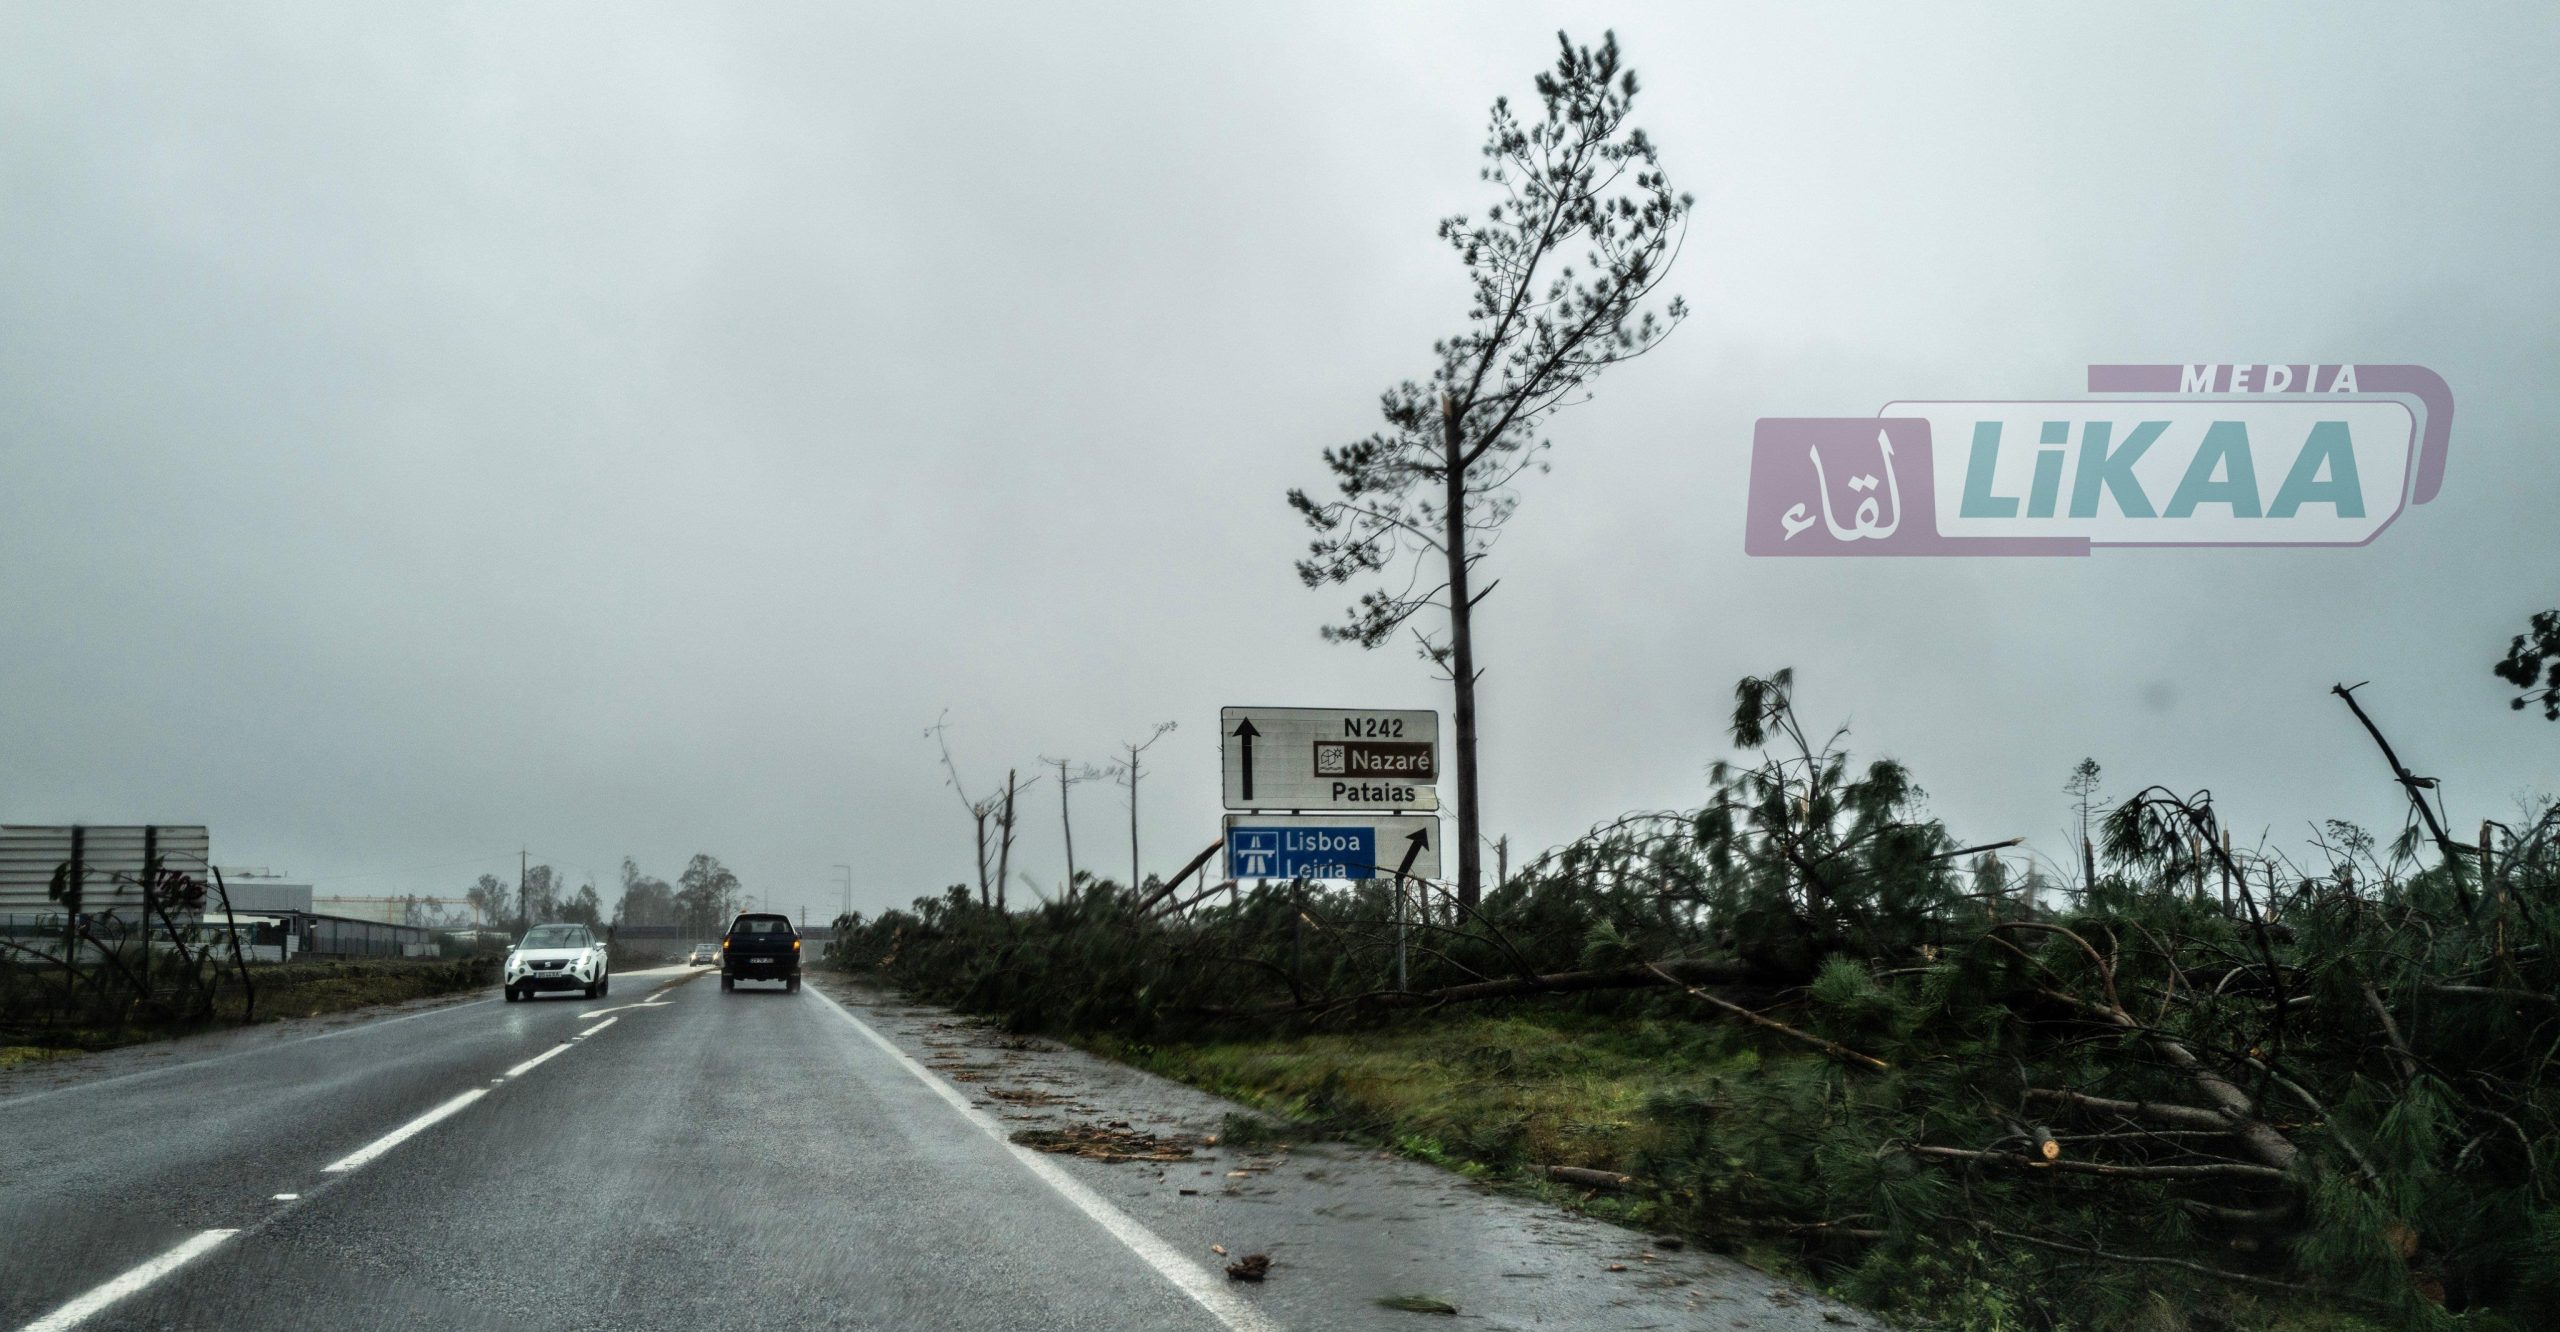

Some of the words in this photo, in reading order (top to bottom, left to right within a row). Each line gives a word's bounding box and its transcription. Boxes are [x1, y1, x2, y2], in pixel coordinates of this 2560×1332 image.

[1352, 749, 1430, 771] Nazaré
[1332, 782, 1416, 802] Pataias
[1286, 831, 1360, 851] Lisboa
[1287, 858, 1347, 879] Leiria
